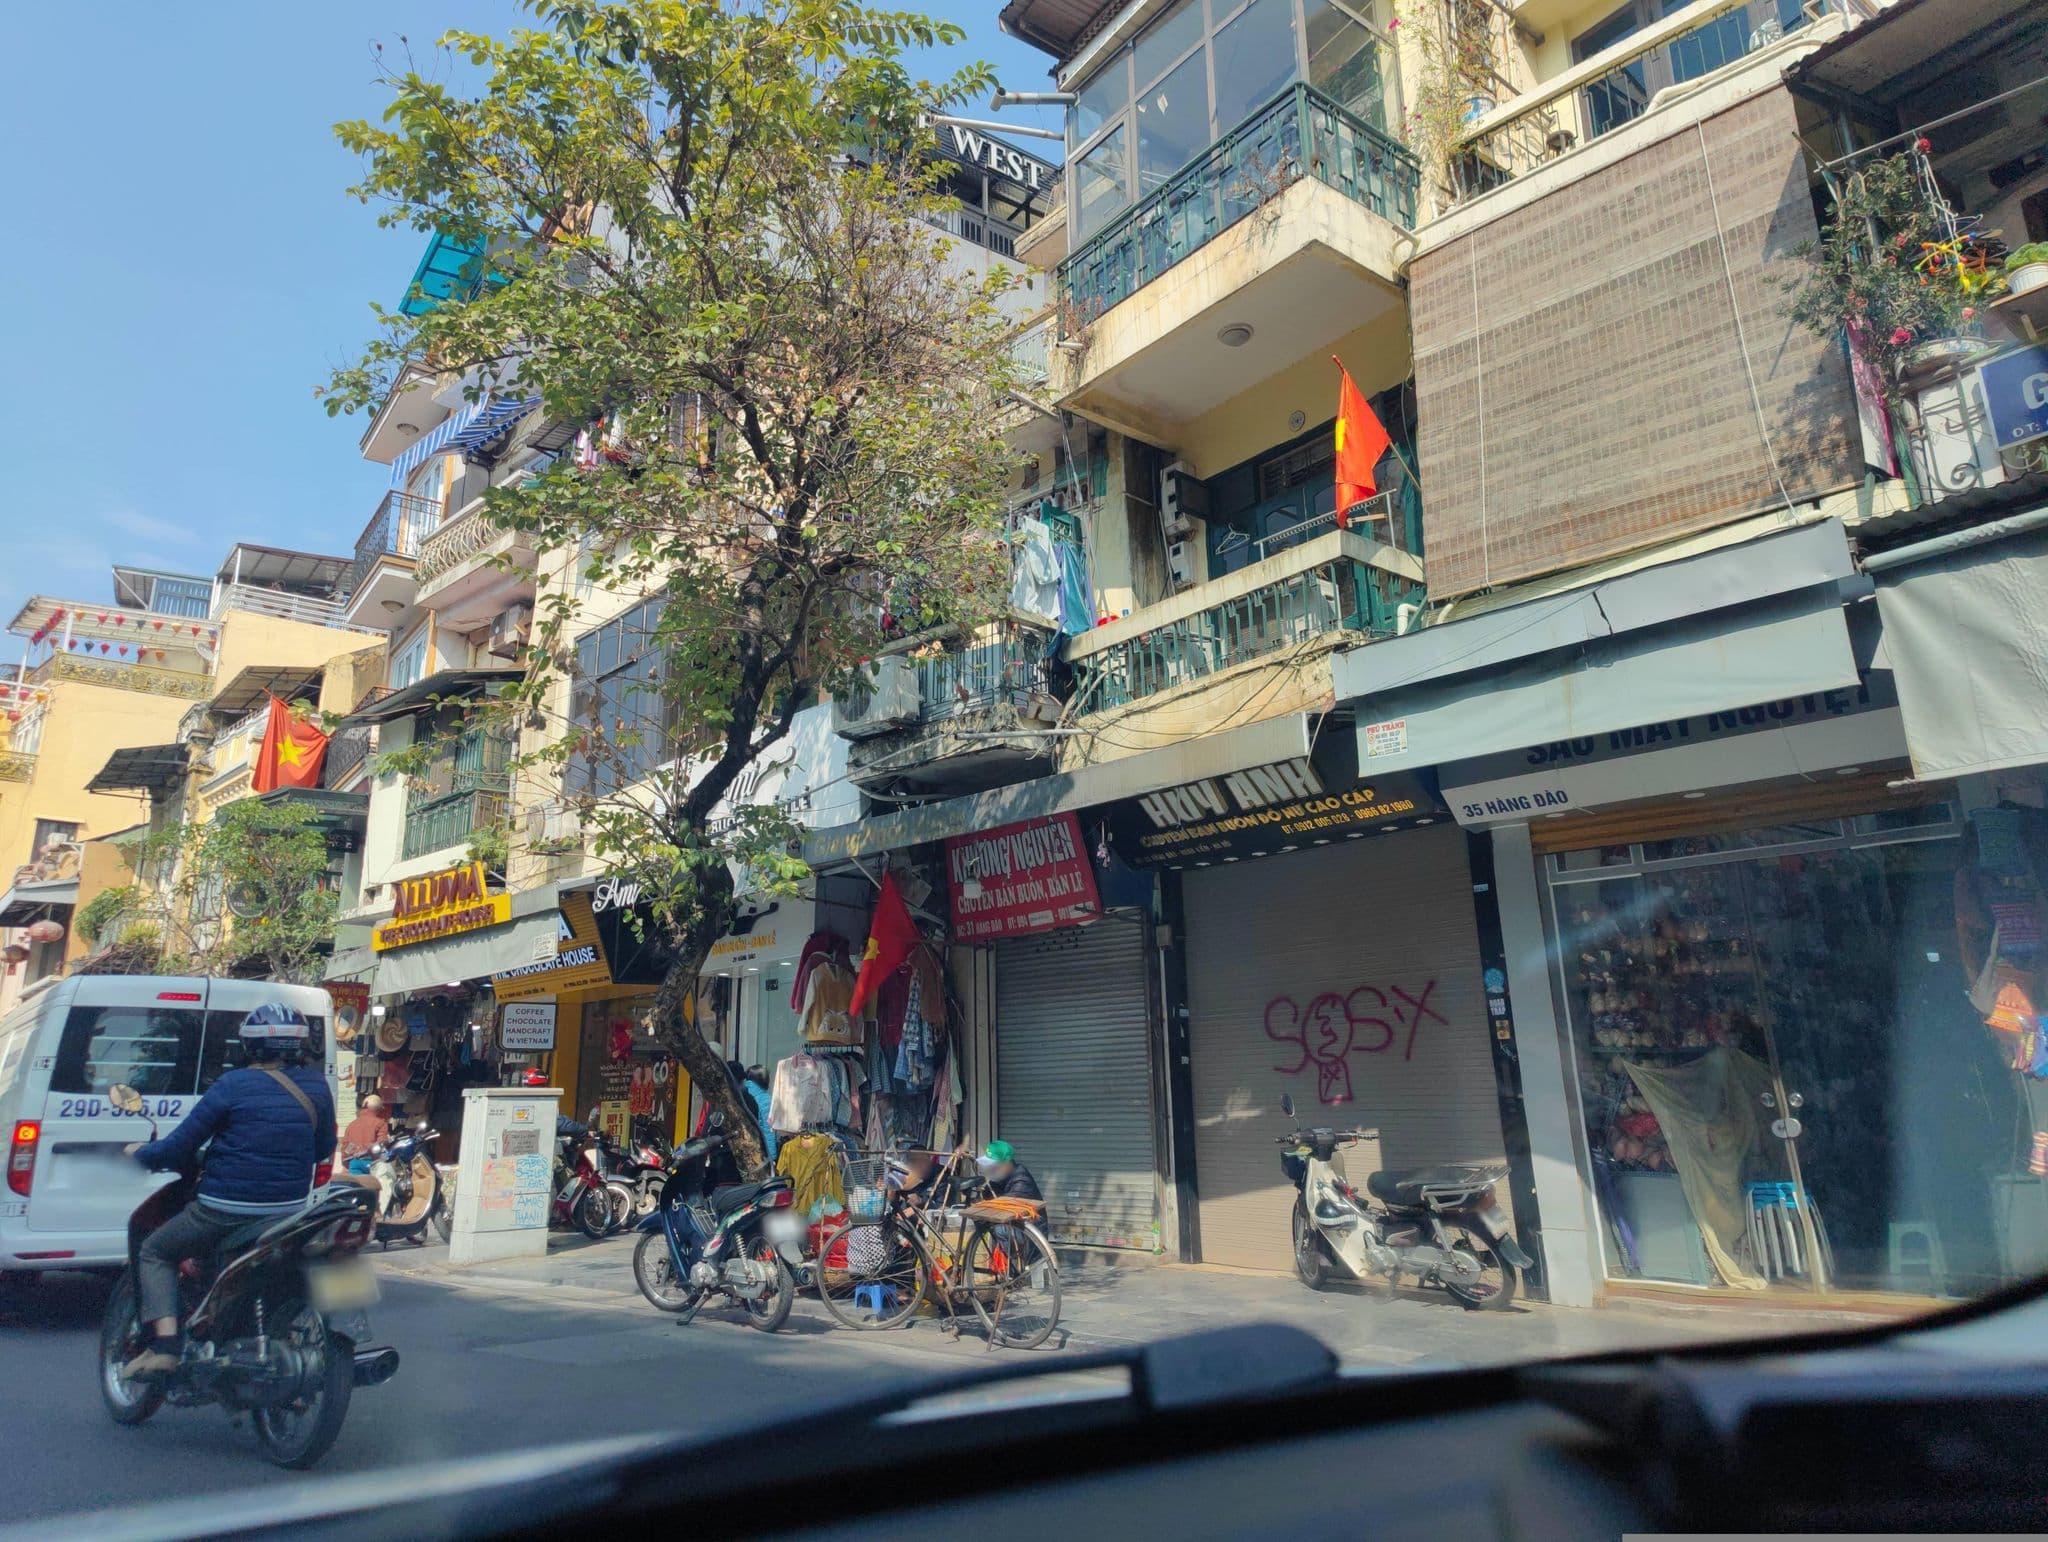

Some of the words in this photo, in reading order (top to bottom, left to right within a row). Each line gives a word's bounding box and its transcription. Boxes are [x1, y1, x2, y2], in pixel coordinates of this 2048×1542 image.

[949, 124, 1043, 190] WEST
[1138, 779, 1227, 828] HUY
[1224, 757, 1323, 810] ANH
[1305, 796, 1341, 814] CAO
[1462, 803, 1484, 818] 35
[1487, 793, 1531, 815] HÀNG
[1535, 789, 1569, 808] ĐÀO
[966, 917, 975, 935] 31
[562, 946, 597, 968] HOUSE
[506, 1017, 552, 1025] CHOCOLATE
[606, 1113, 617, 1124] BUY
[618, 1113, 623, 1123] 5
